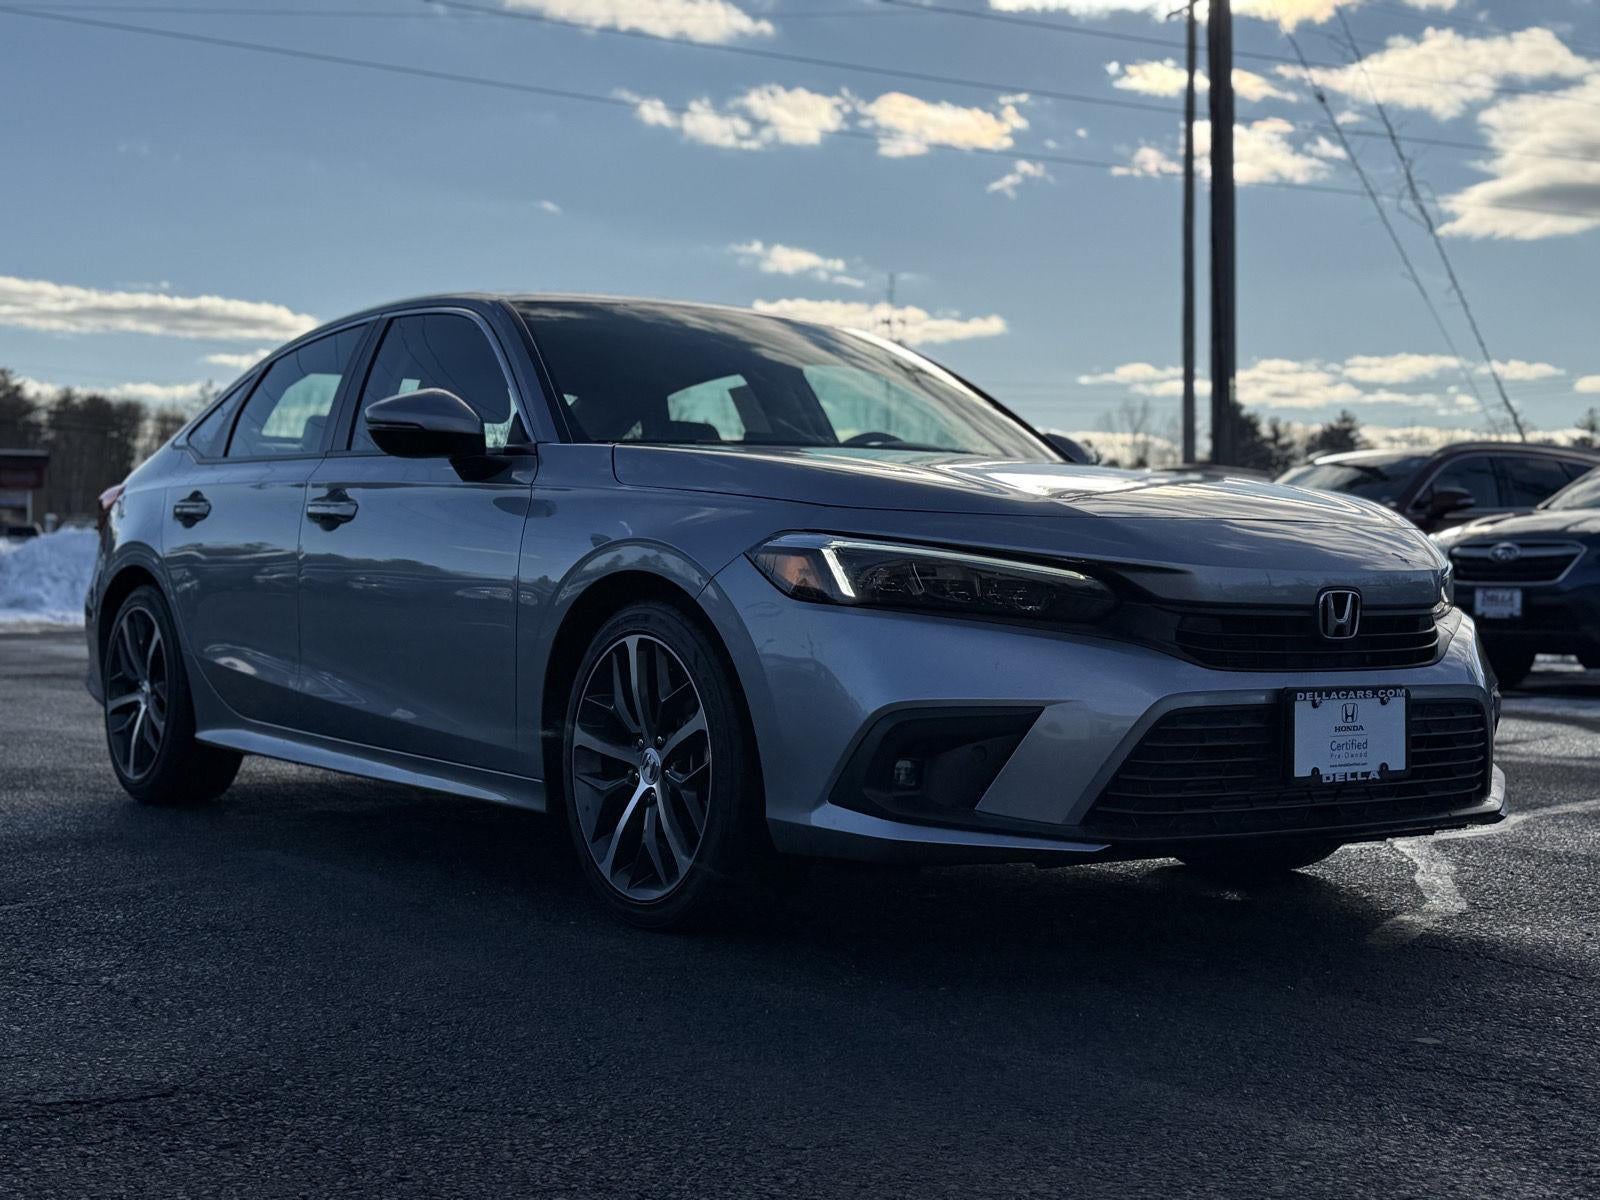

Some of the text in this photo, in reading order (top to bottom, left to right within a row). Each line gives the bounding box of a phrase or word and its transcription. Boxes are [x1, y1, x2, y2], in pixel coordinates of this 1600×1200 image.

[1297, 689, 1406, 700] DELLACARS.COM
[1330, 740, 1368, 752] Certified
[1322, 770, 1380, 783] DELLA
